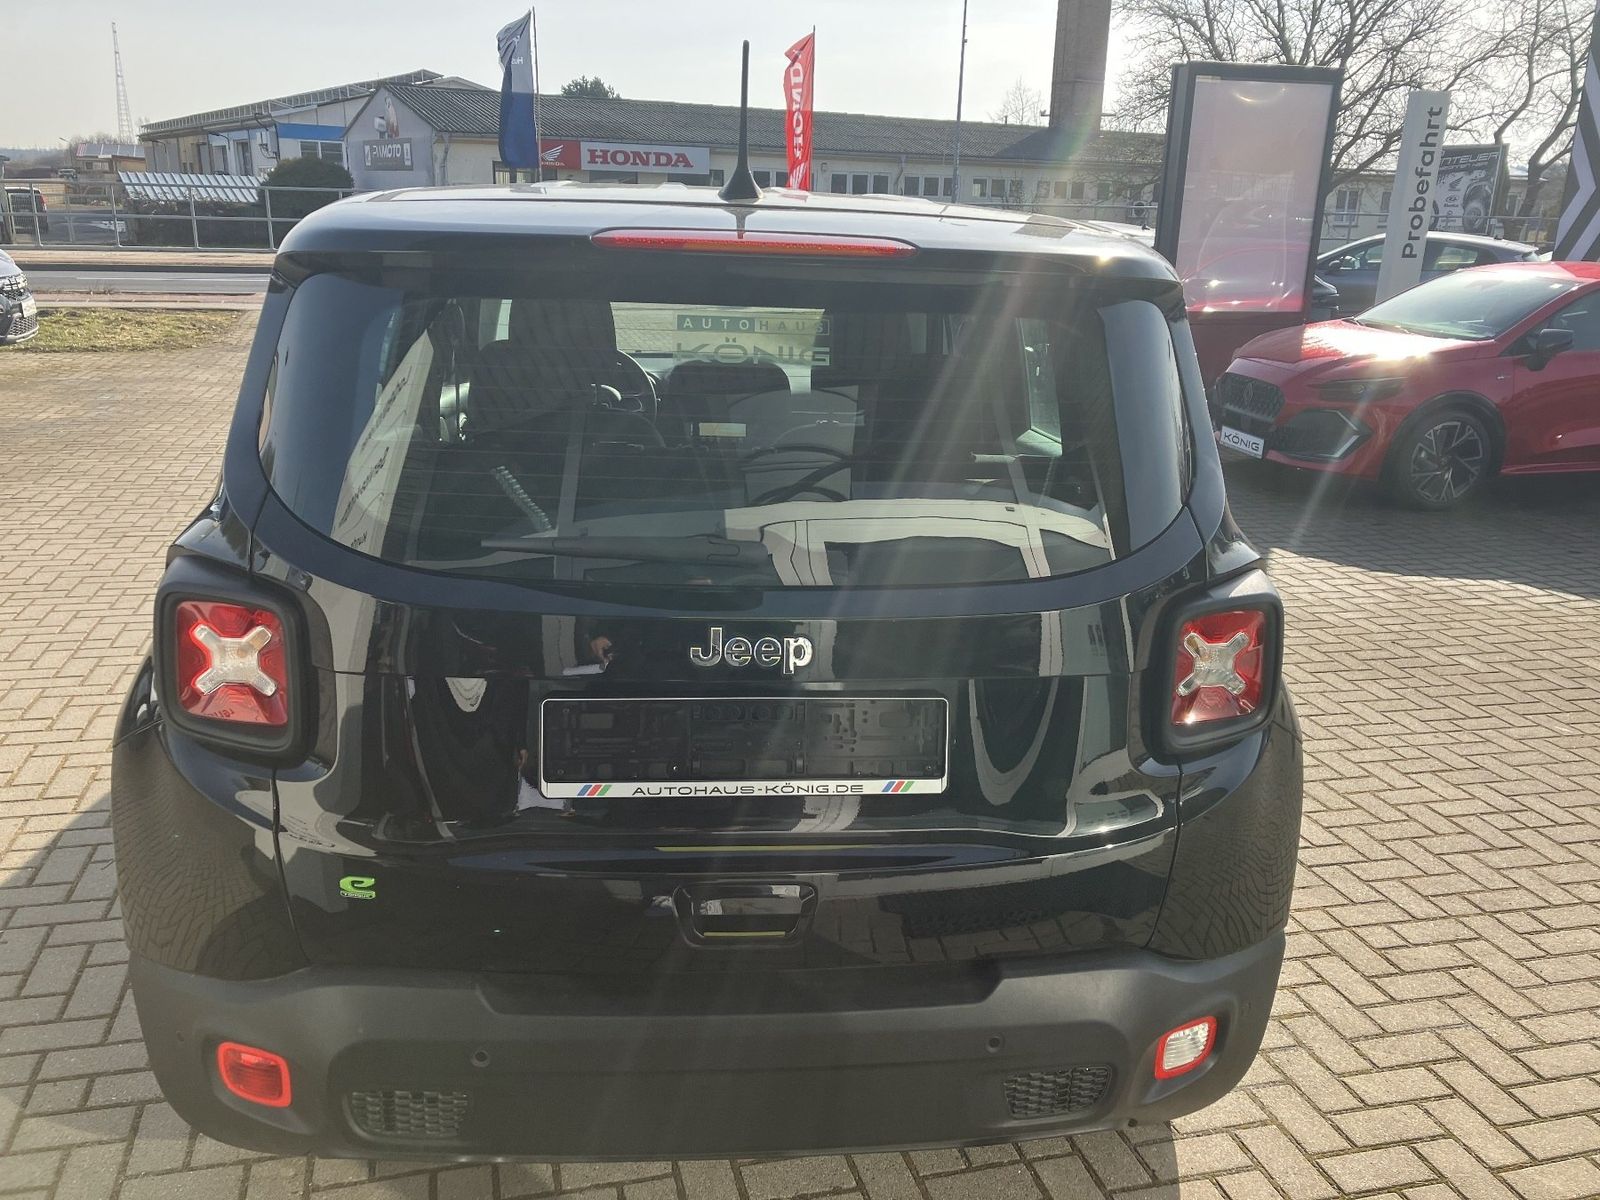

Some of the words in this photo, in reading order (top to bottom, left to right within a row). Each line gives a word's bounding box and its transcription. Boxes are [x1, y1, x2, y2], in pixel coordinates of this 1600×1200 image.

[587, 148, 694, 168] HONDA
[1401, 106, 1442, 258] Probefahrt
[683, 318, 824, 333] AUTOHAUS
[672, 336, 830, 367] KÖNIG
[1223, 431, 1260, 452] KÖNIG
[690, 627, 813, 674] Jeep
[632, 782, 864, 796] AUTOHAUS-KÖNIG.DE
